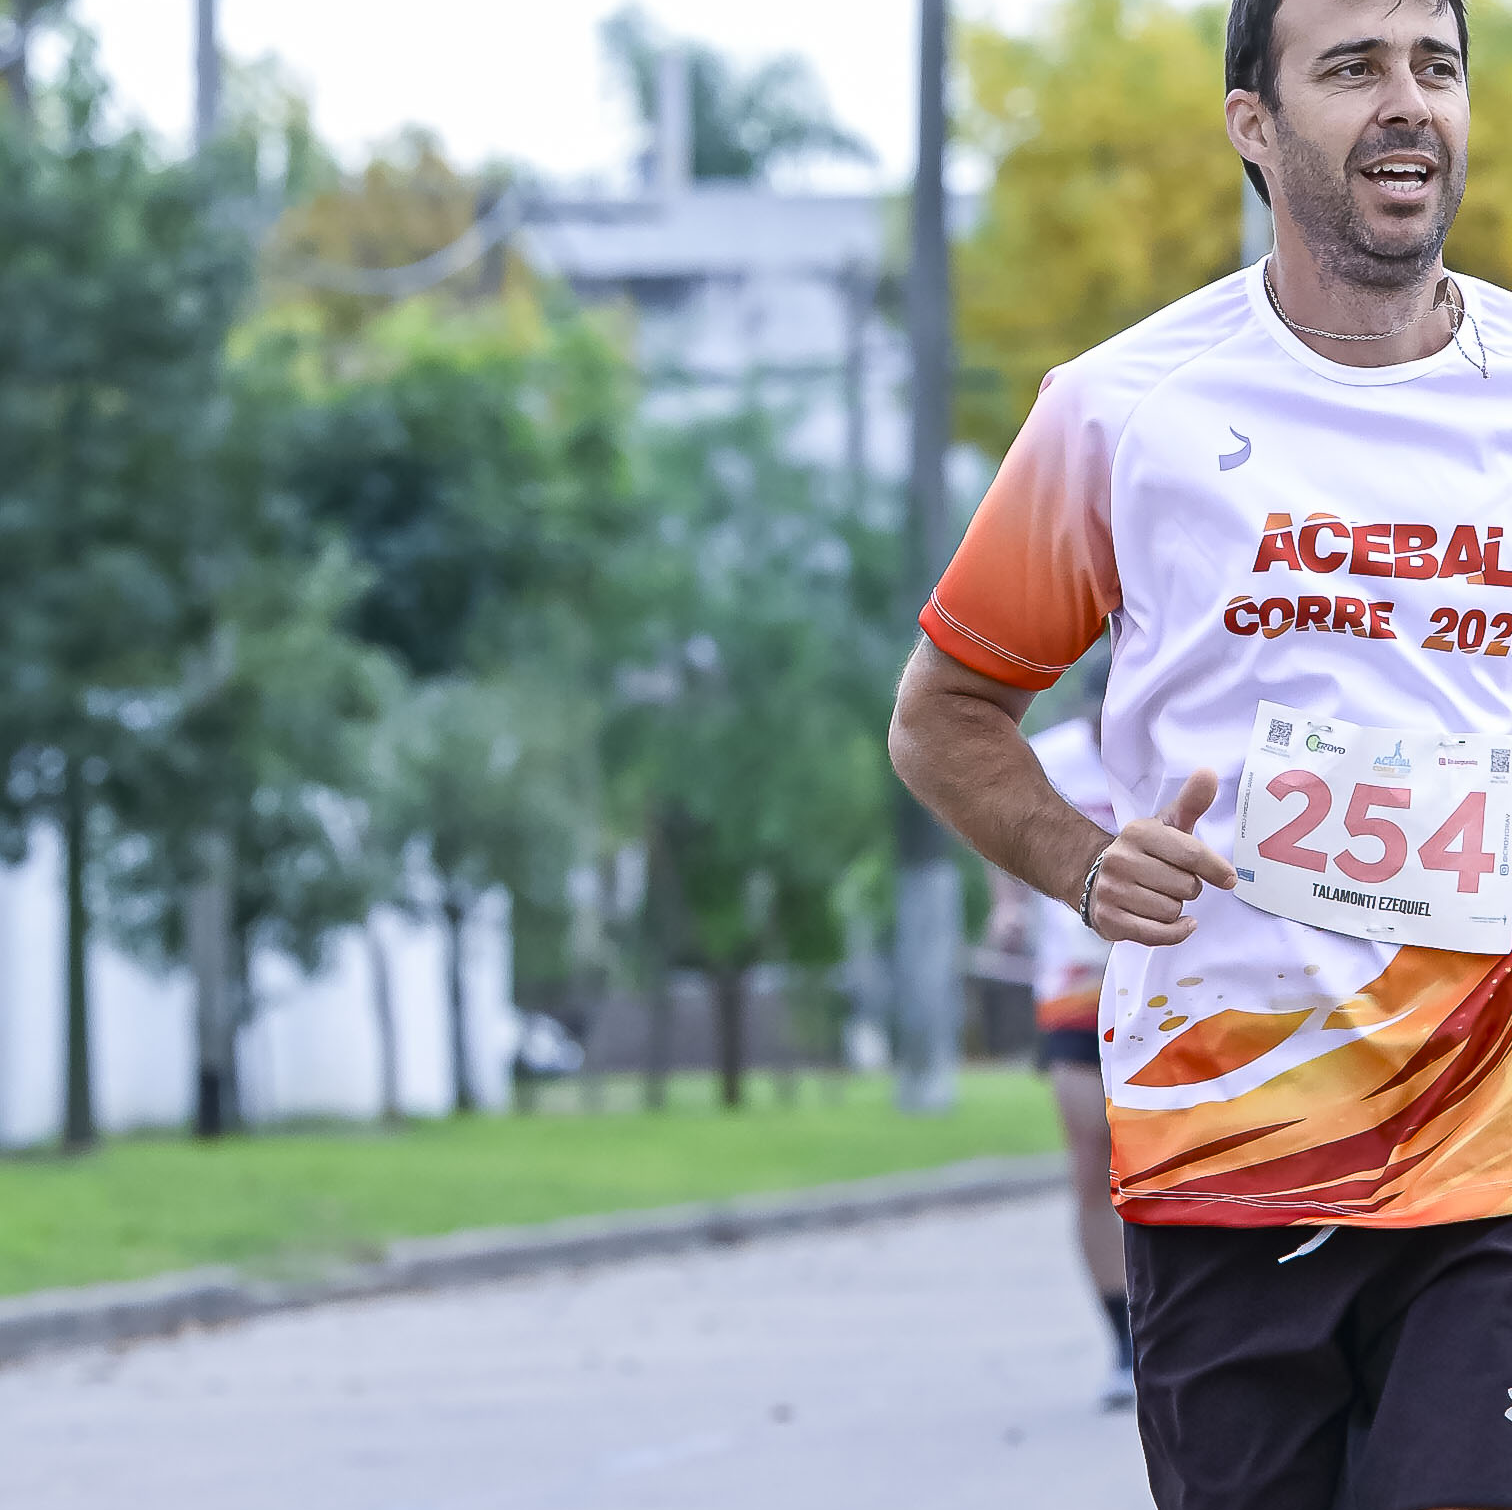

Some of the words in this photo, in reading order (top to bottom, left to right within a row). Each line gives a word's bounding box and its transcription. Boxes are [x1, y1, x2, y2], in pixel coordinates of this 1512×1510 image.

[1224, 595, 1397, 640] CORRE
[1258, 769, 1495, 893] 254
[1312, 882, 1376, 910] TALAMONTI
[1379, 895, 1431, 916] EZEQUIEL
